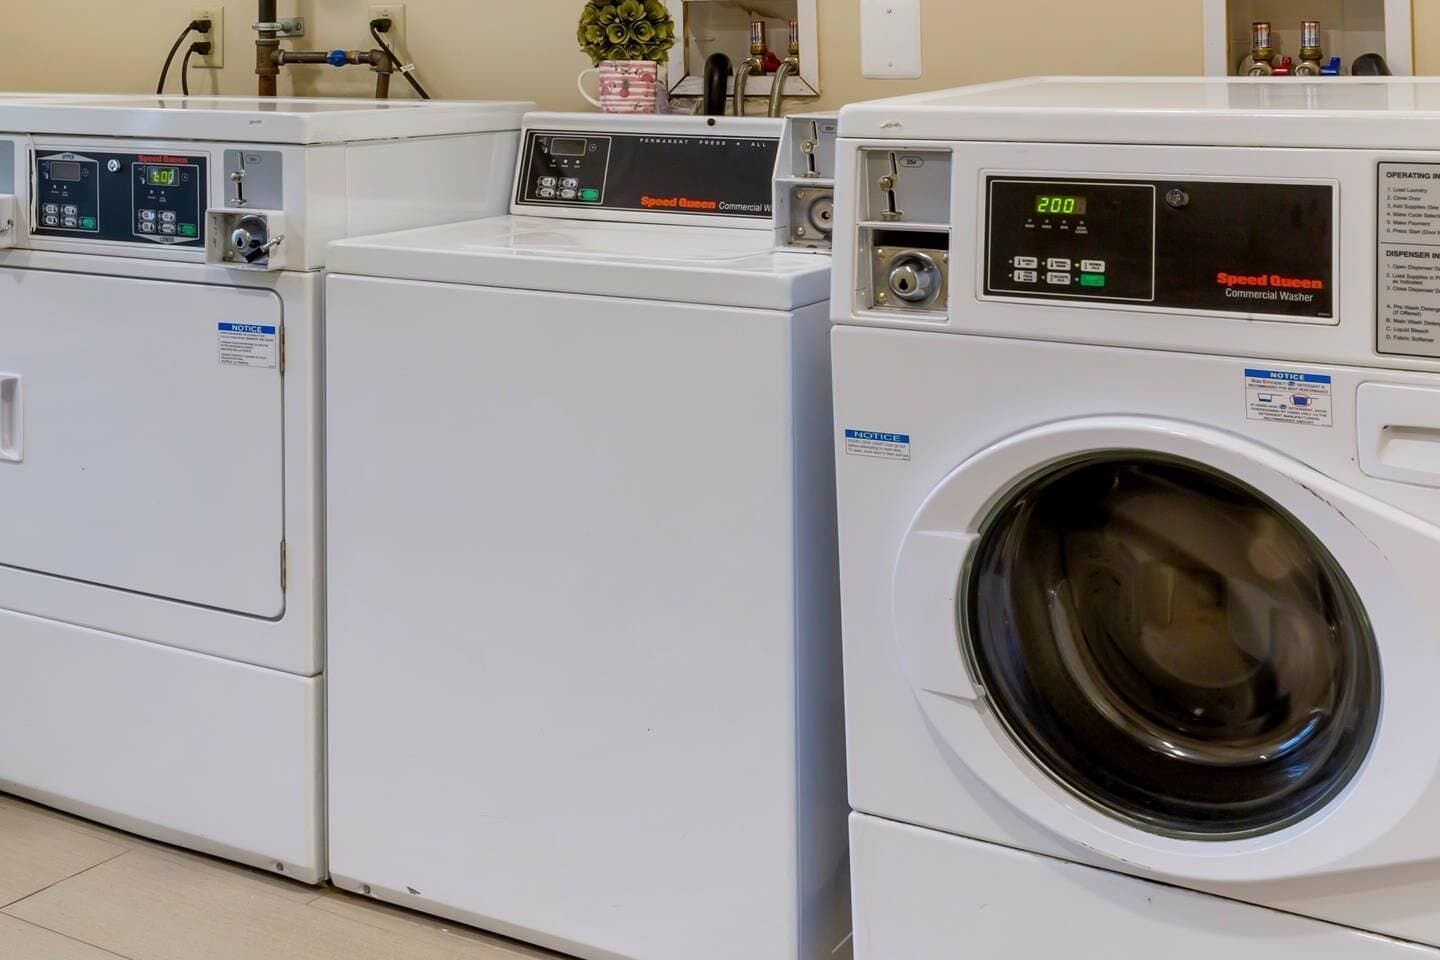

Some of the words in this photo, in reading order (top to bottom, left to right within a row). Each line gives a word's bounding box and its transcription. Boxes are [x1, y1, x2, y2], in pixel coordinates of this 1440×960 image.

[1386, 171, 1431, 180] OPERATING
[641, 196, 678, 208] Speed
[678, 197, 716, 209] Queen
[719, 201, 762, 211] Commercial
[1037, 197, 1075, 214] 200
[1386, 250, 1430, 259] DISPENSER
[1217, 272, 1267, 287] Speed
[1270, 275, 1322, 289] Queen
[1225, 287, 1278, 300] Commercial
[1280, 291, 1313, 302] Washer
[232, 324, 263, 333] NOTICE
[1270, 372, 1305, 381] NOTICE
[854, 431, 901, 442] NOTICE
